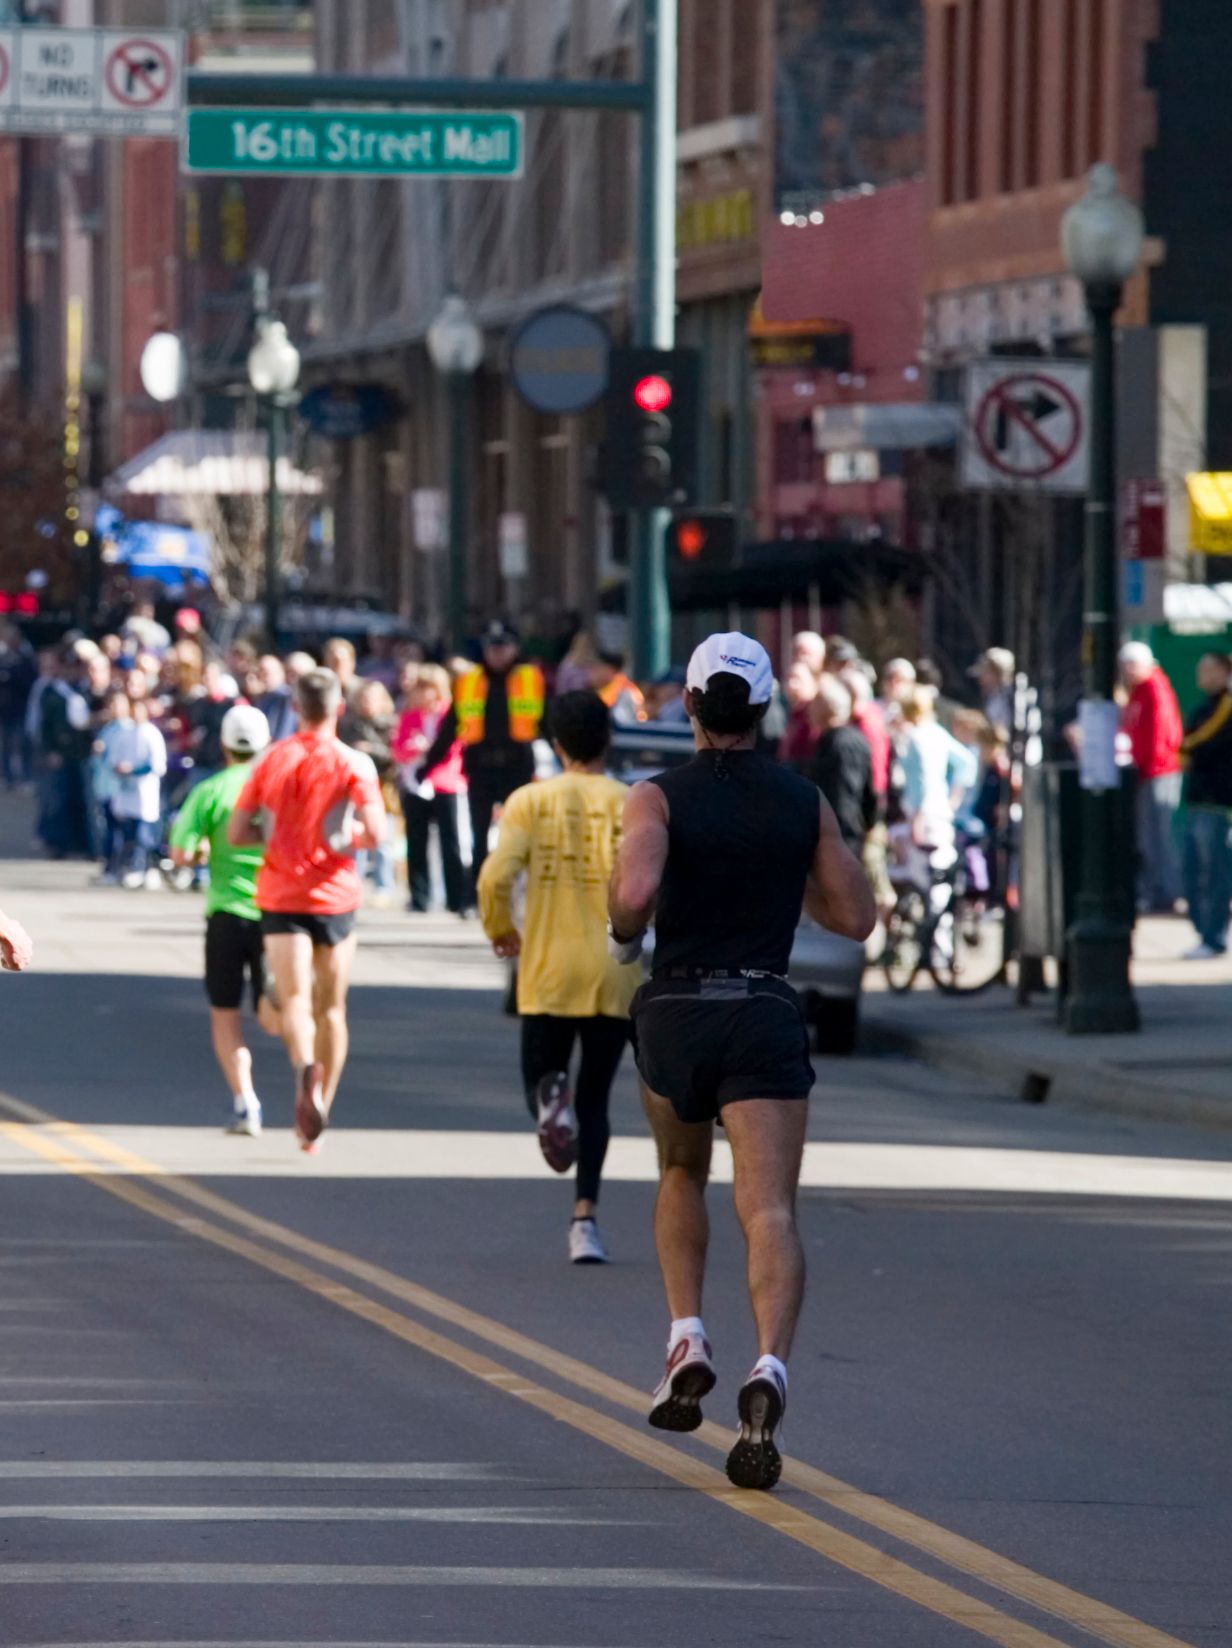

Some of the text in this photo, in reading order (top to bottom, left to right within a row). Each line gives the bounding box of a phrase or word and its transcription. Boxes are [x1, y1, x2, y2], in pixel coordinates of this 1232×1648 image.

[39, 43, 72, 64] NO
[23, 73, 91, 97] TURNS
[232, 121, 510, 164] 16th Street Mall
